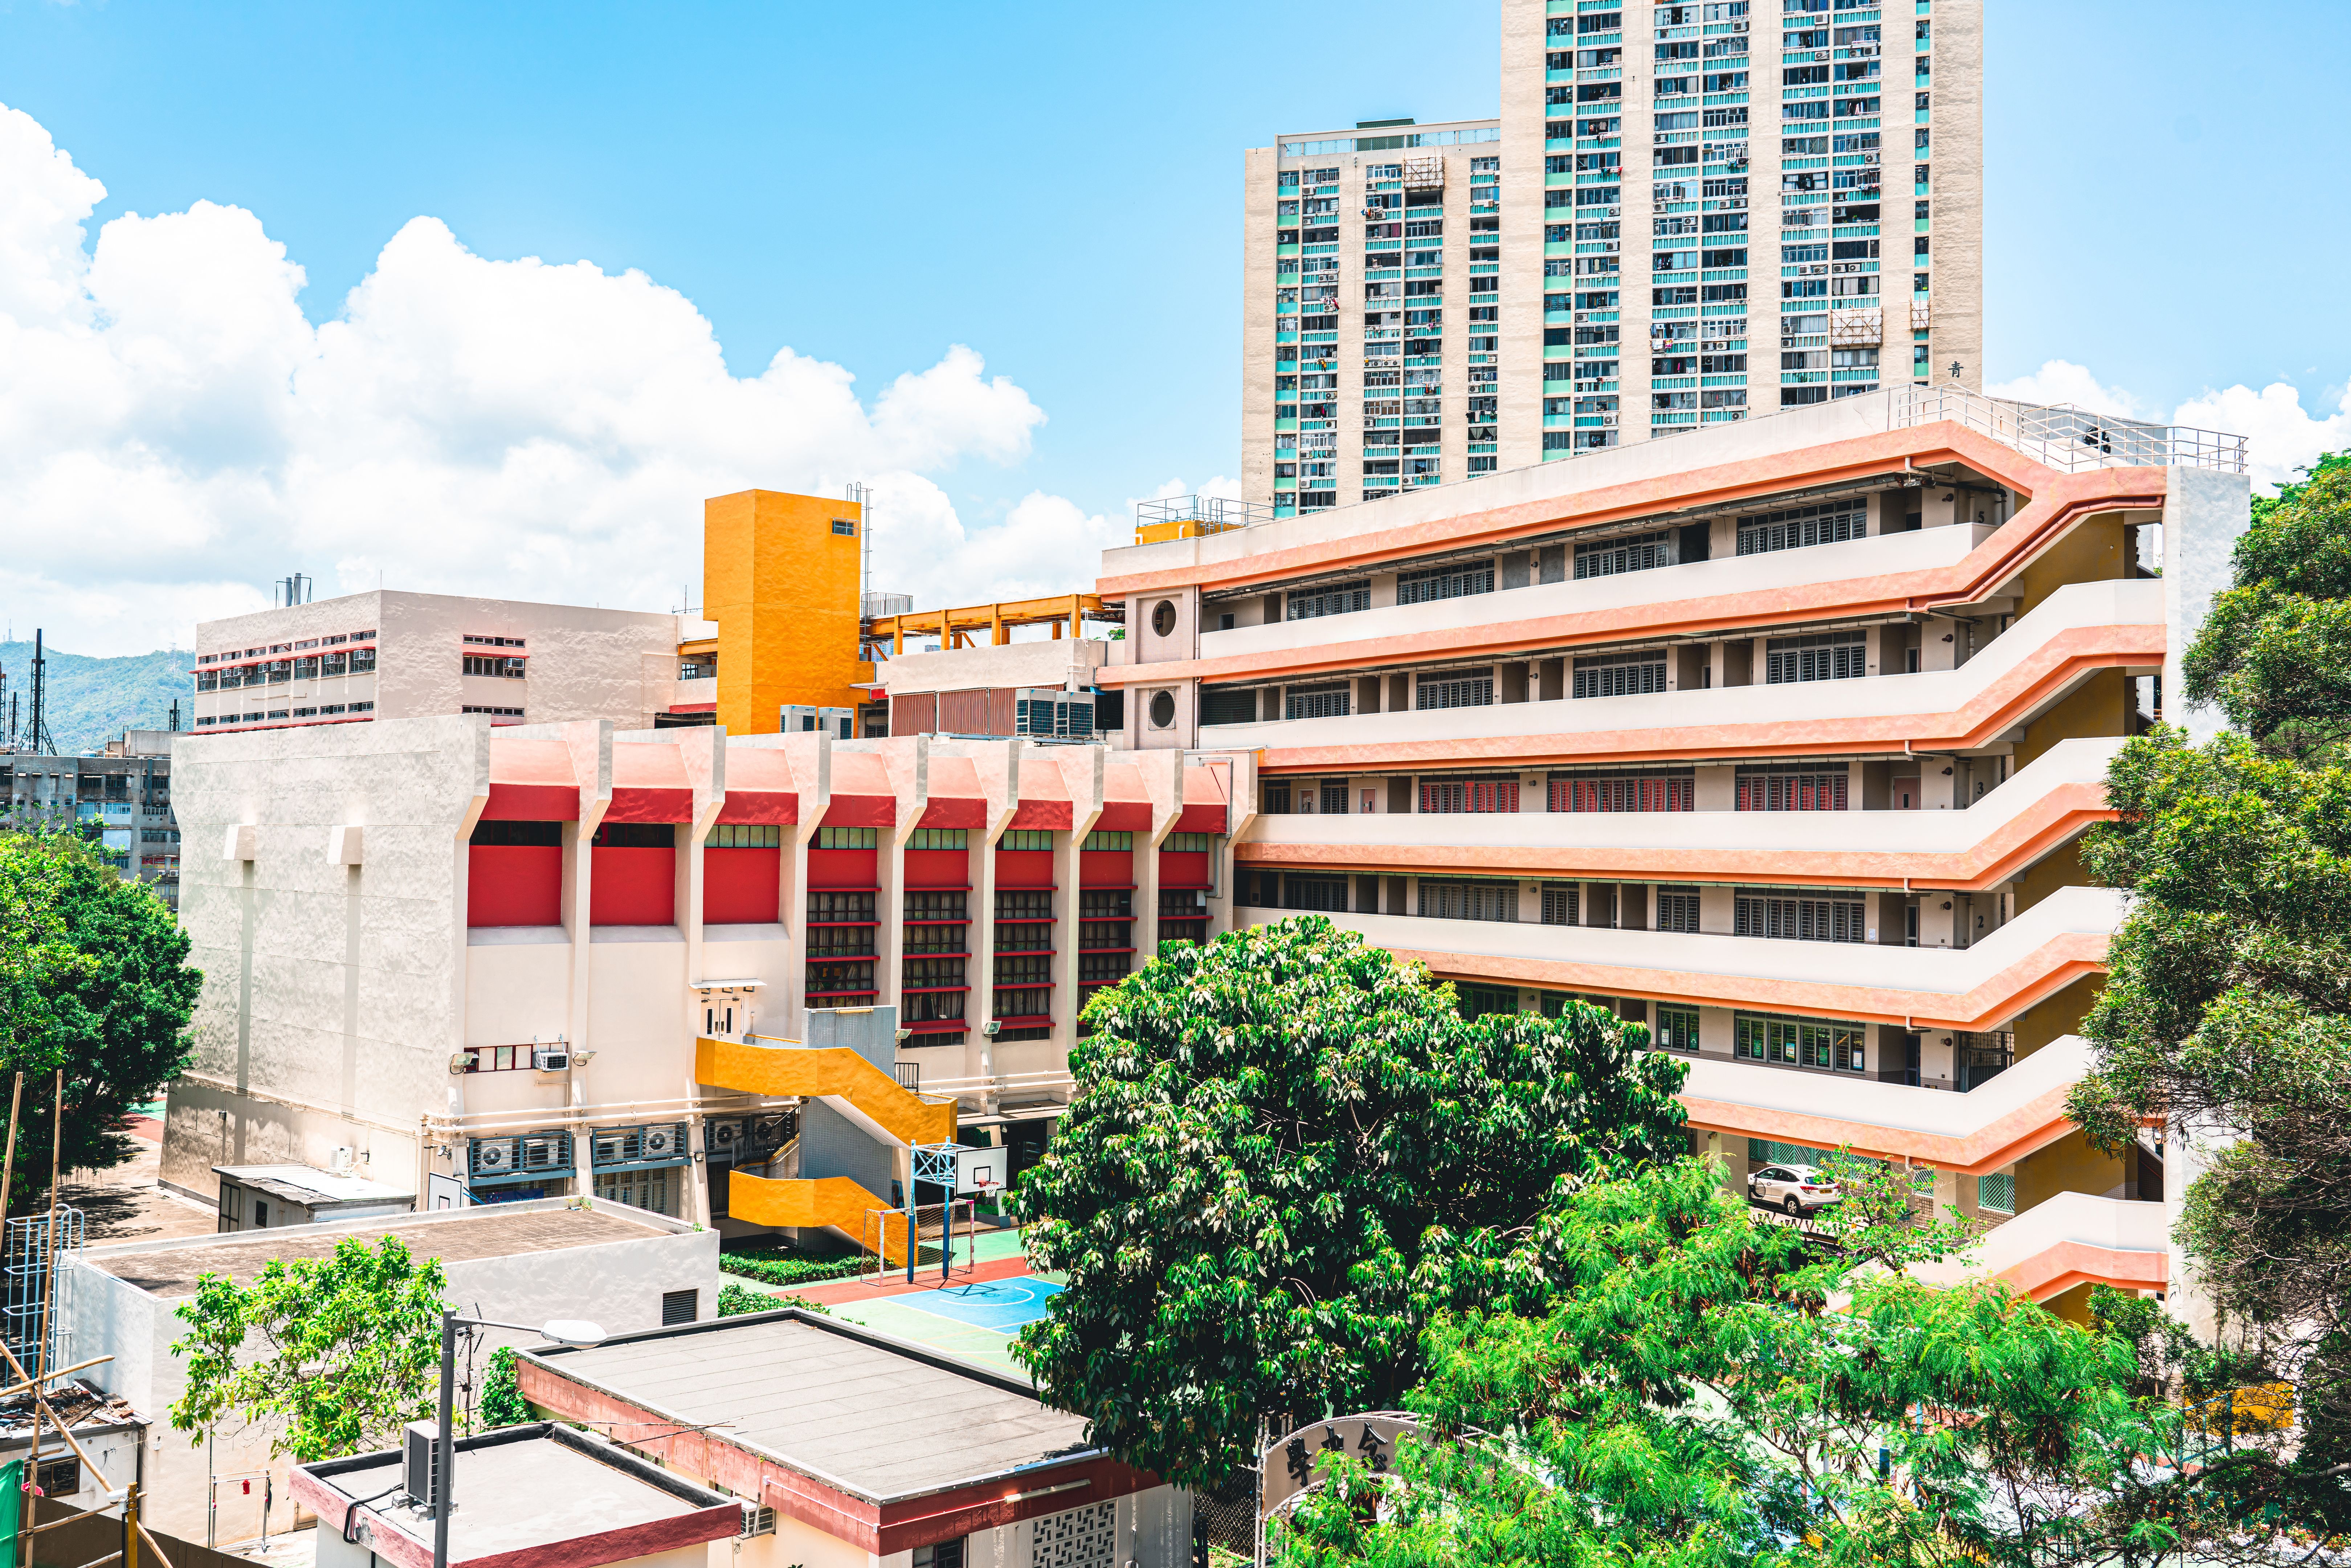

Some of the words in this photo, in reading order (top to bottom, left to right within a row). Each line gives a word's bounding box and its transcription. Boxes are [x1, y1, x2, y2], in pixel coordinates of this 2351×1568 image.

[1948, 361, 1964, 378] 青
[1978, 511, 1984, 523] 5
[1977, 782, 1983, 794] 3
[1978, 915, 1984, 928] 2
